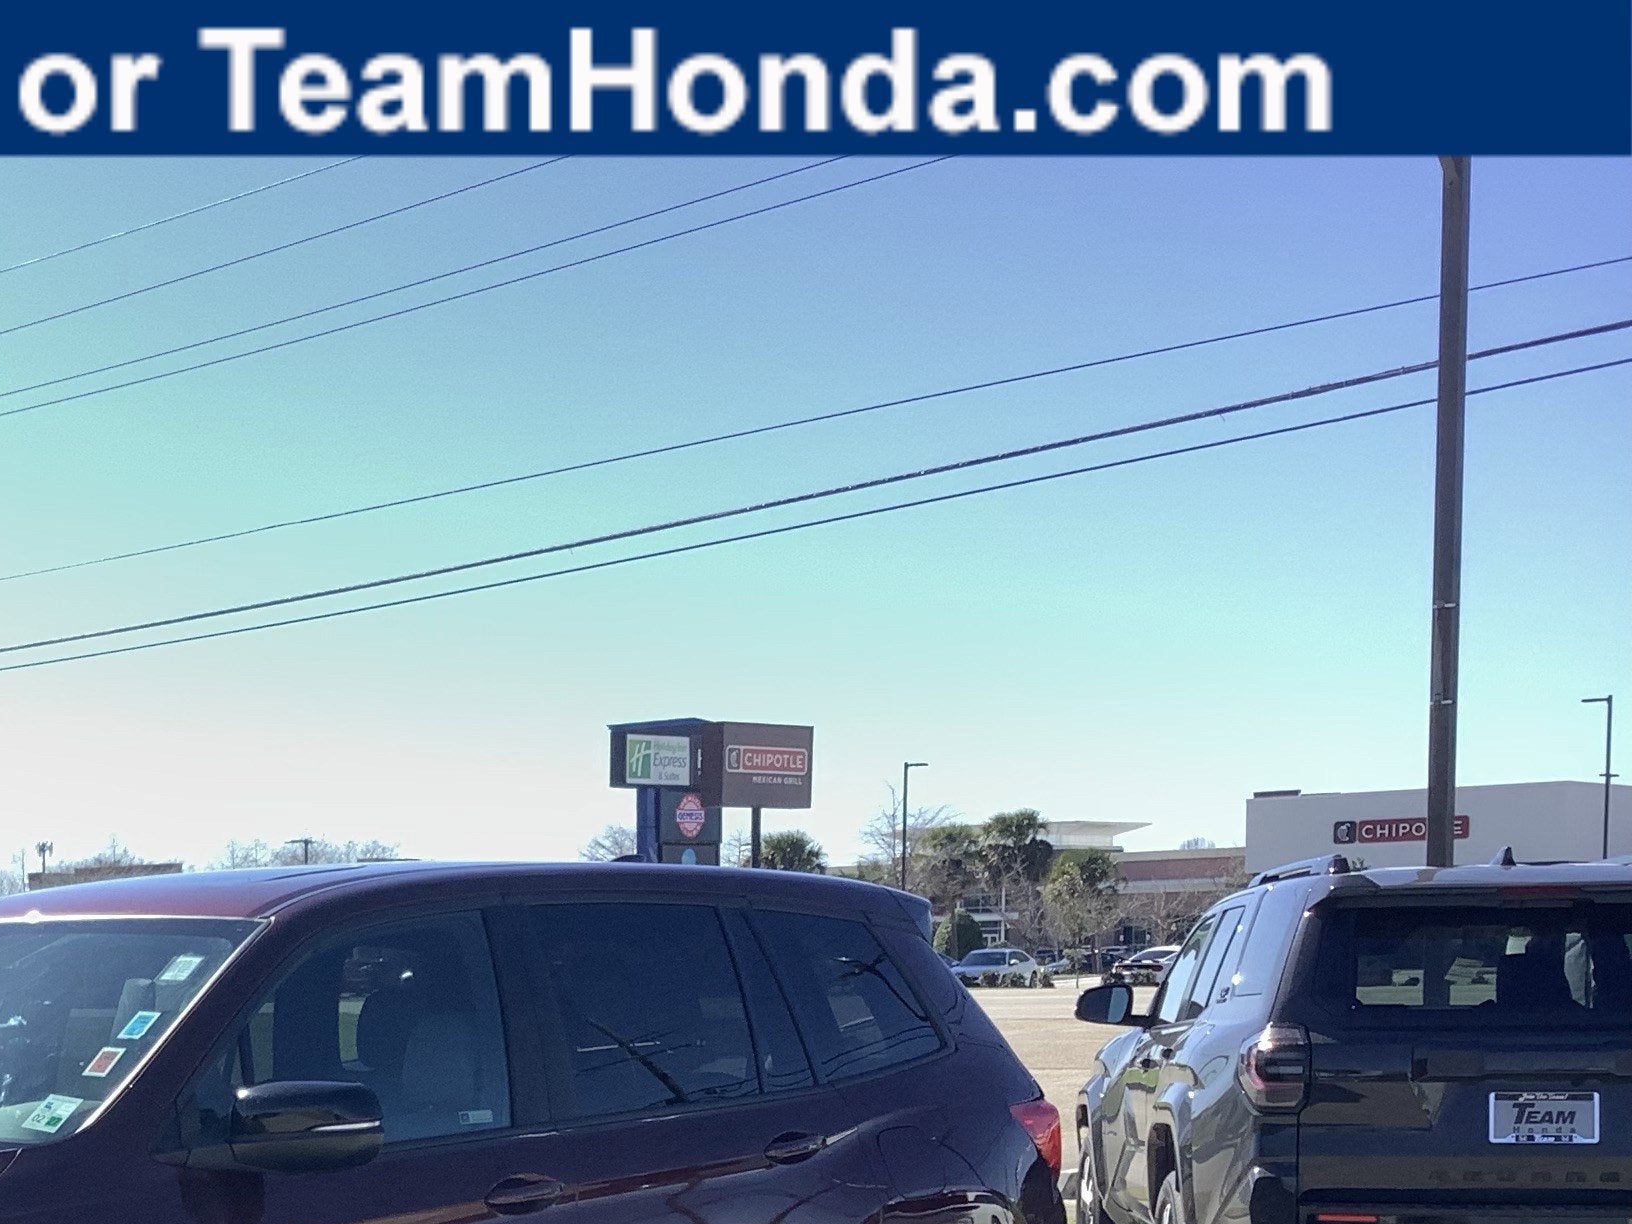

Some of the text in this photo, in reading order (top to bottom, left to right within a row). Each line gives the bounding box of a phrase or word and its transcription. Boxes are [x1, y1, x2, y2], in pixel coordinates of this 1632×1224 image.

[653, 752, 687, 769] Express
[744, 752, 804, 769] CHIPOTLE
[752, 776, 803, 786] MEXICAN GRILL
[1361, 820, 1463, 839] CHIPOE
[1512, 1126, 1577, 1134] Honda
